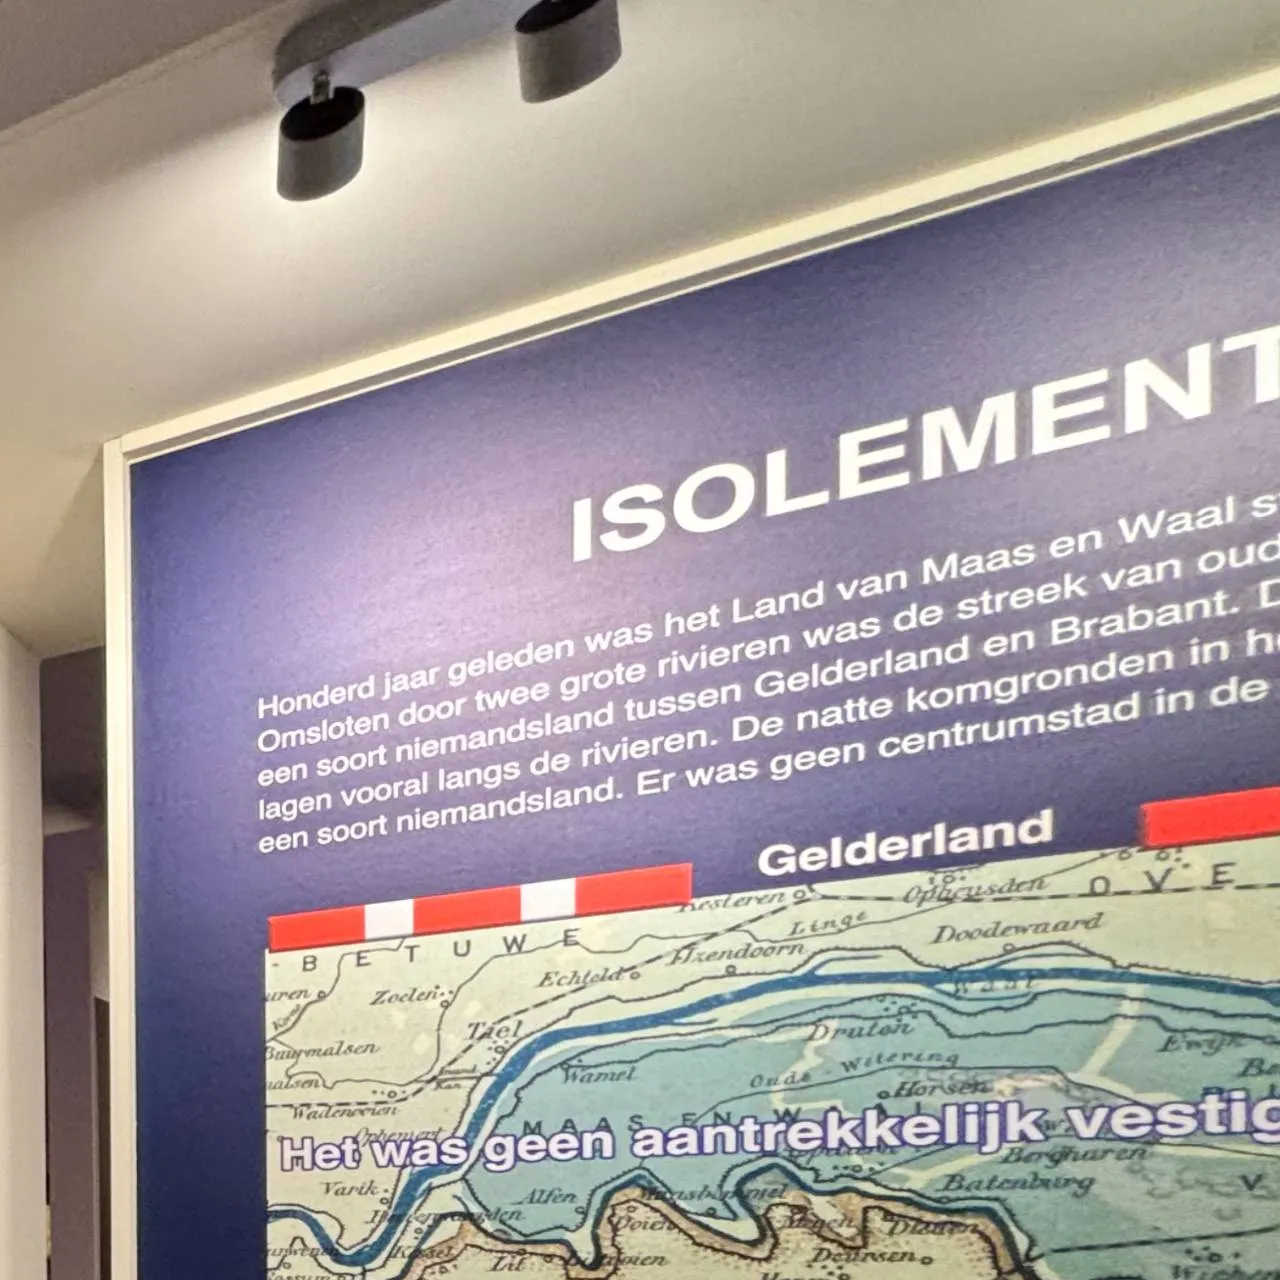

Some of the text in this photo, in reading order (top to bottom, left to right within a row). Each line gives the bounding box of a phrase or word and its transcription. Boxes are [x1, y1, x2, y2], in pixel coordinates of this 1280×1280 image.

[573, 326, 1280, 561] ISOLEMENT
[258, 698, 389, 751] Omsloten
[399, 697, 467, 726] door
[475, 683, 549, 711] twee
[560, 663, 646, 701] grote
[658, 635, 789, 677] rivieren
[803, 618, 880, 648] was
[894, 603, 943, 631] de
[958, 573, 1088, 619] streek
[1101, 559, 1181, 590] van
[258, 763, 307, 786] een
[317, 745, 387, 776] soort
[396, 701, 613, 762] niemandsland
[624, 684, 741, 721] tussen
[755, 635, 969, 697] Gelderland
[983, 631, 1034, 656] en
[1051, 591, 1239, 645] Brabant.
[259, 675, 375, 718] Honderd
[382, 667, 440, 700] jaar
[448, 640, 574, 686] geleden
[584, 623, 653, 652] was
[665, 605, 720, 636] het
[733, 581, 823, 623] Land
[837, 571, 907, 600] van
[923, 544, 1036, 584] Maas
[1050, 531, 1102, 558] en
[1118, 496, 1234, 542] Waal
[259, 676, 1269, 853] een soort niemandsland. Er was geen centrumstad in de
[260, 793, 331, 821] lagen
[341, 772, 428, 806] vooral
[439, 762, 520, 790] langs
[530, 751, 570, 775] de
[582, 730, 717, 767] rivieren.
[733, 716, 783, 741] De
[798, 697, 893, 731] natte
[907, 650, 1173, 712] komgronden
[1191, 638, 1229, 665] in
[758, 809, 1053, 877] Gelderland
[930, 911, 1106, 945] Doodewaard
[464, 1019, 523, 1041] Tiel
[280, 1137, 361, 1172] Het
[370, 1139, 469, 1168] was
[485, 1131, 615, 1173] geen
[632, 1100, 1046, 1158] aantrekkelijk
[322, 1181, 380, 1197] Varik
